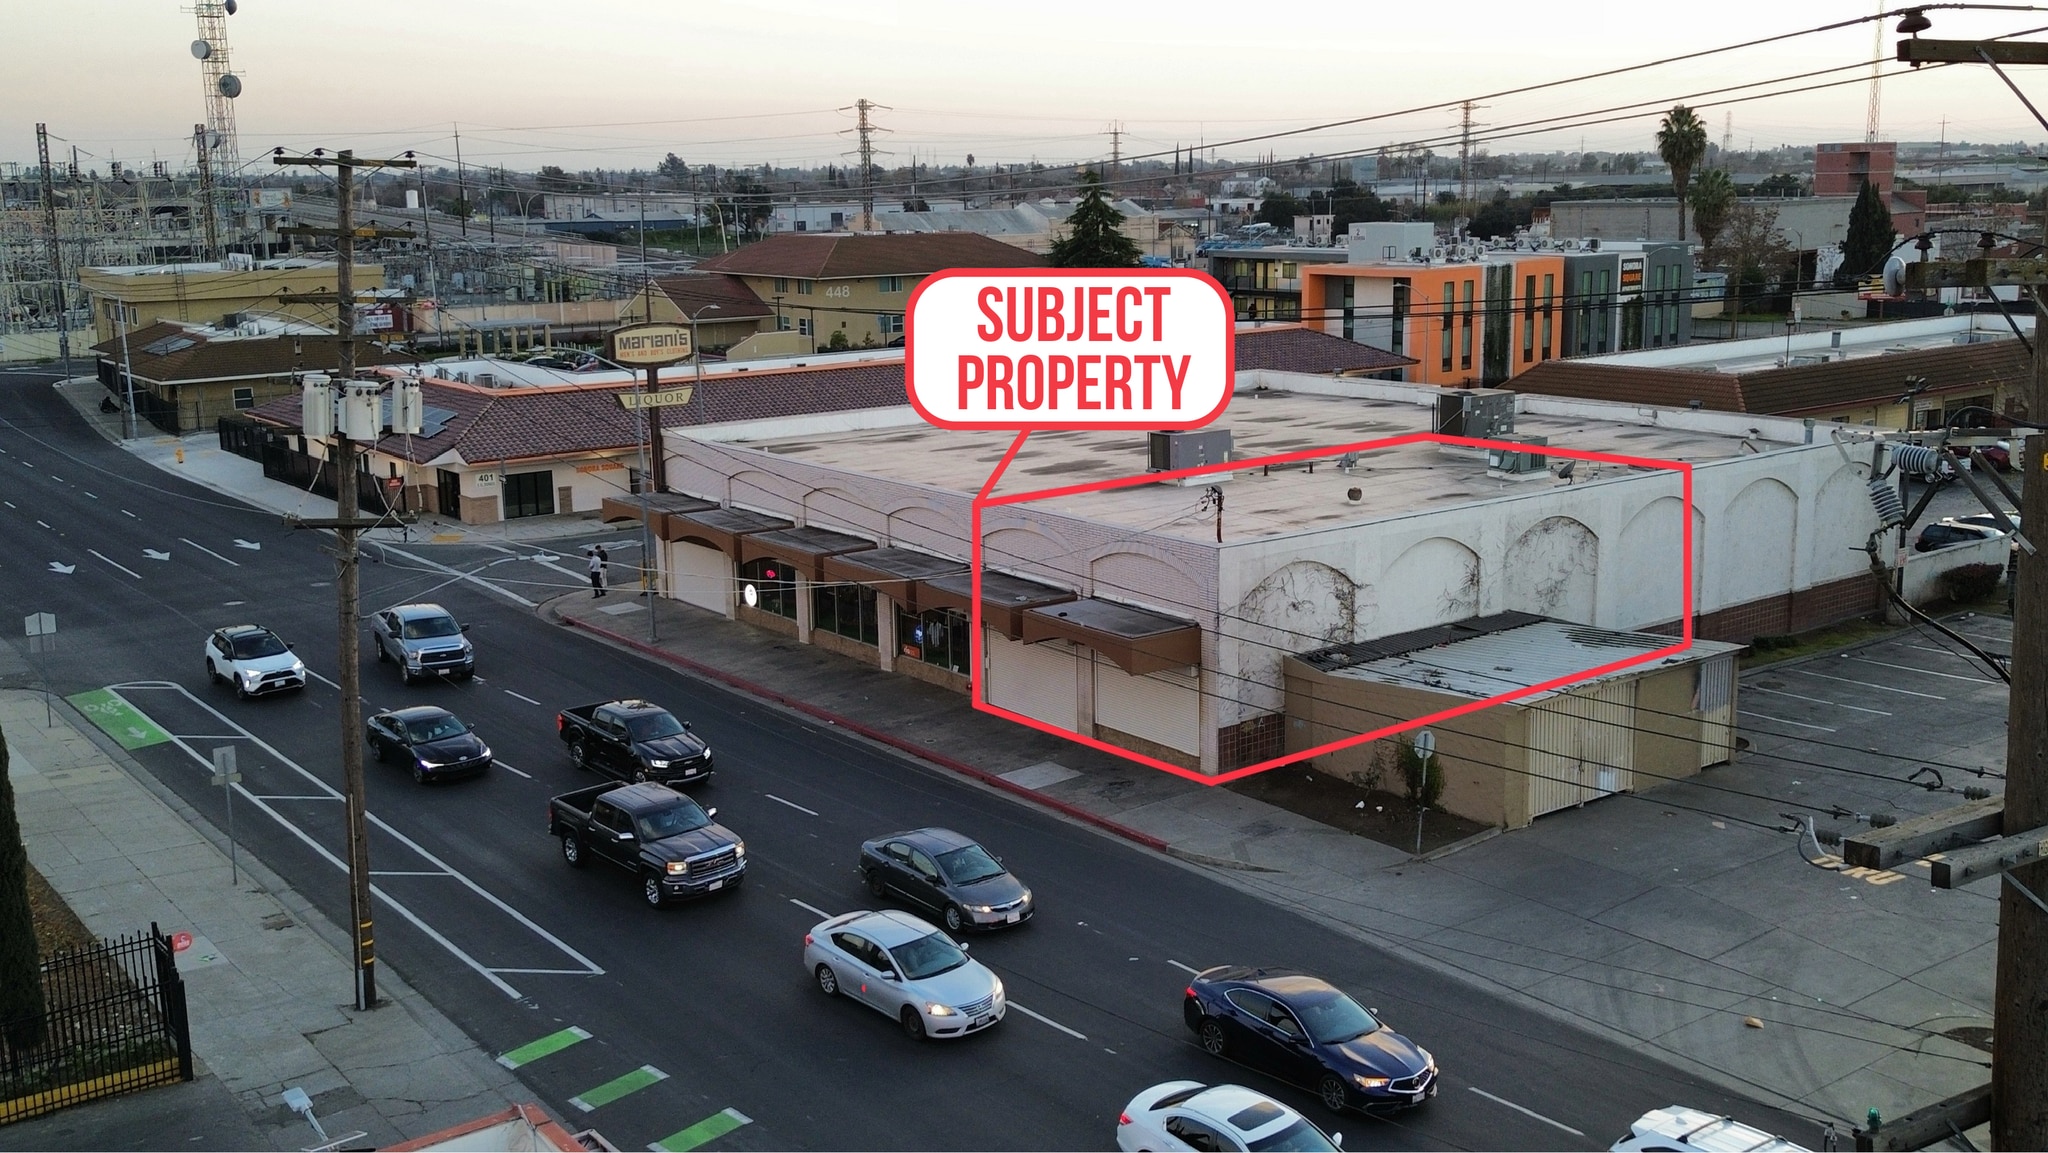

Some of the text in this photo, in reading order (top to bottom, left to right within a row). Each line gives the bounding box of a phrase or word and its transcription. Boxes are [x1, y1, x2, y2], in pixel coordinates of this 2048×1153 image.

[826, 285, 850, 298] 448
[619, 329, 688, 350] Mariani's
[629, 392, 684, 407] LIQUOR
[478, 473, 494, 482] 401
